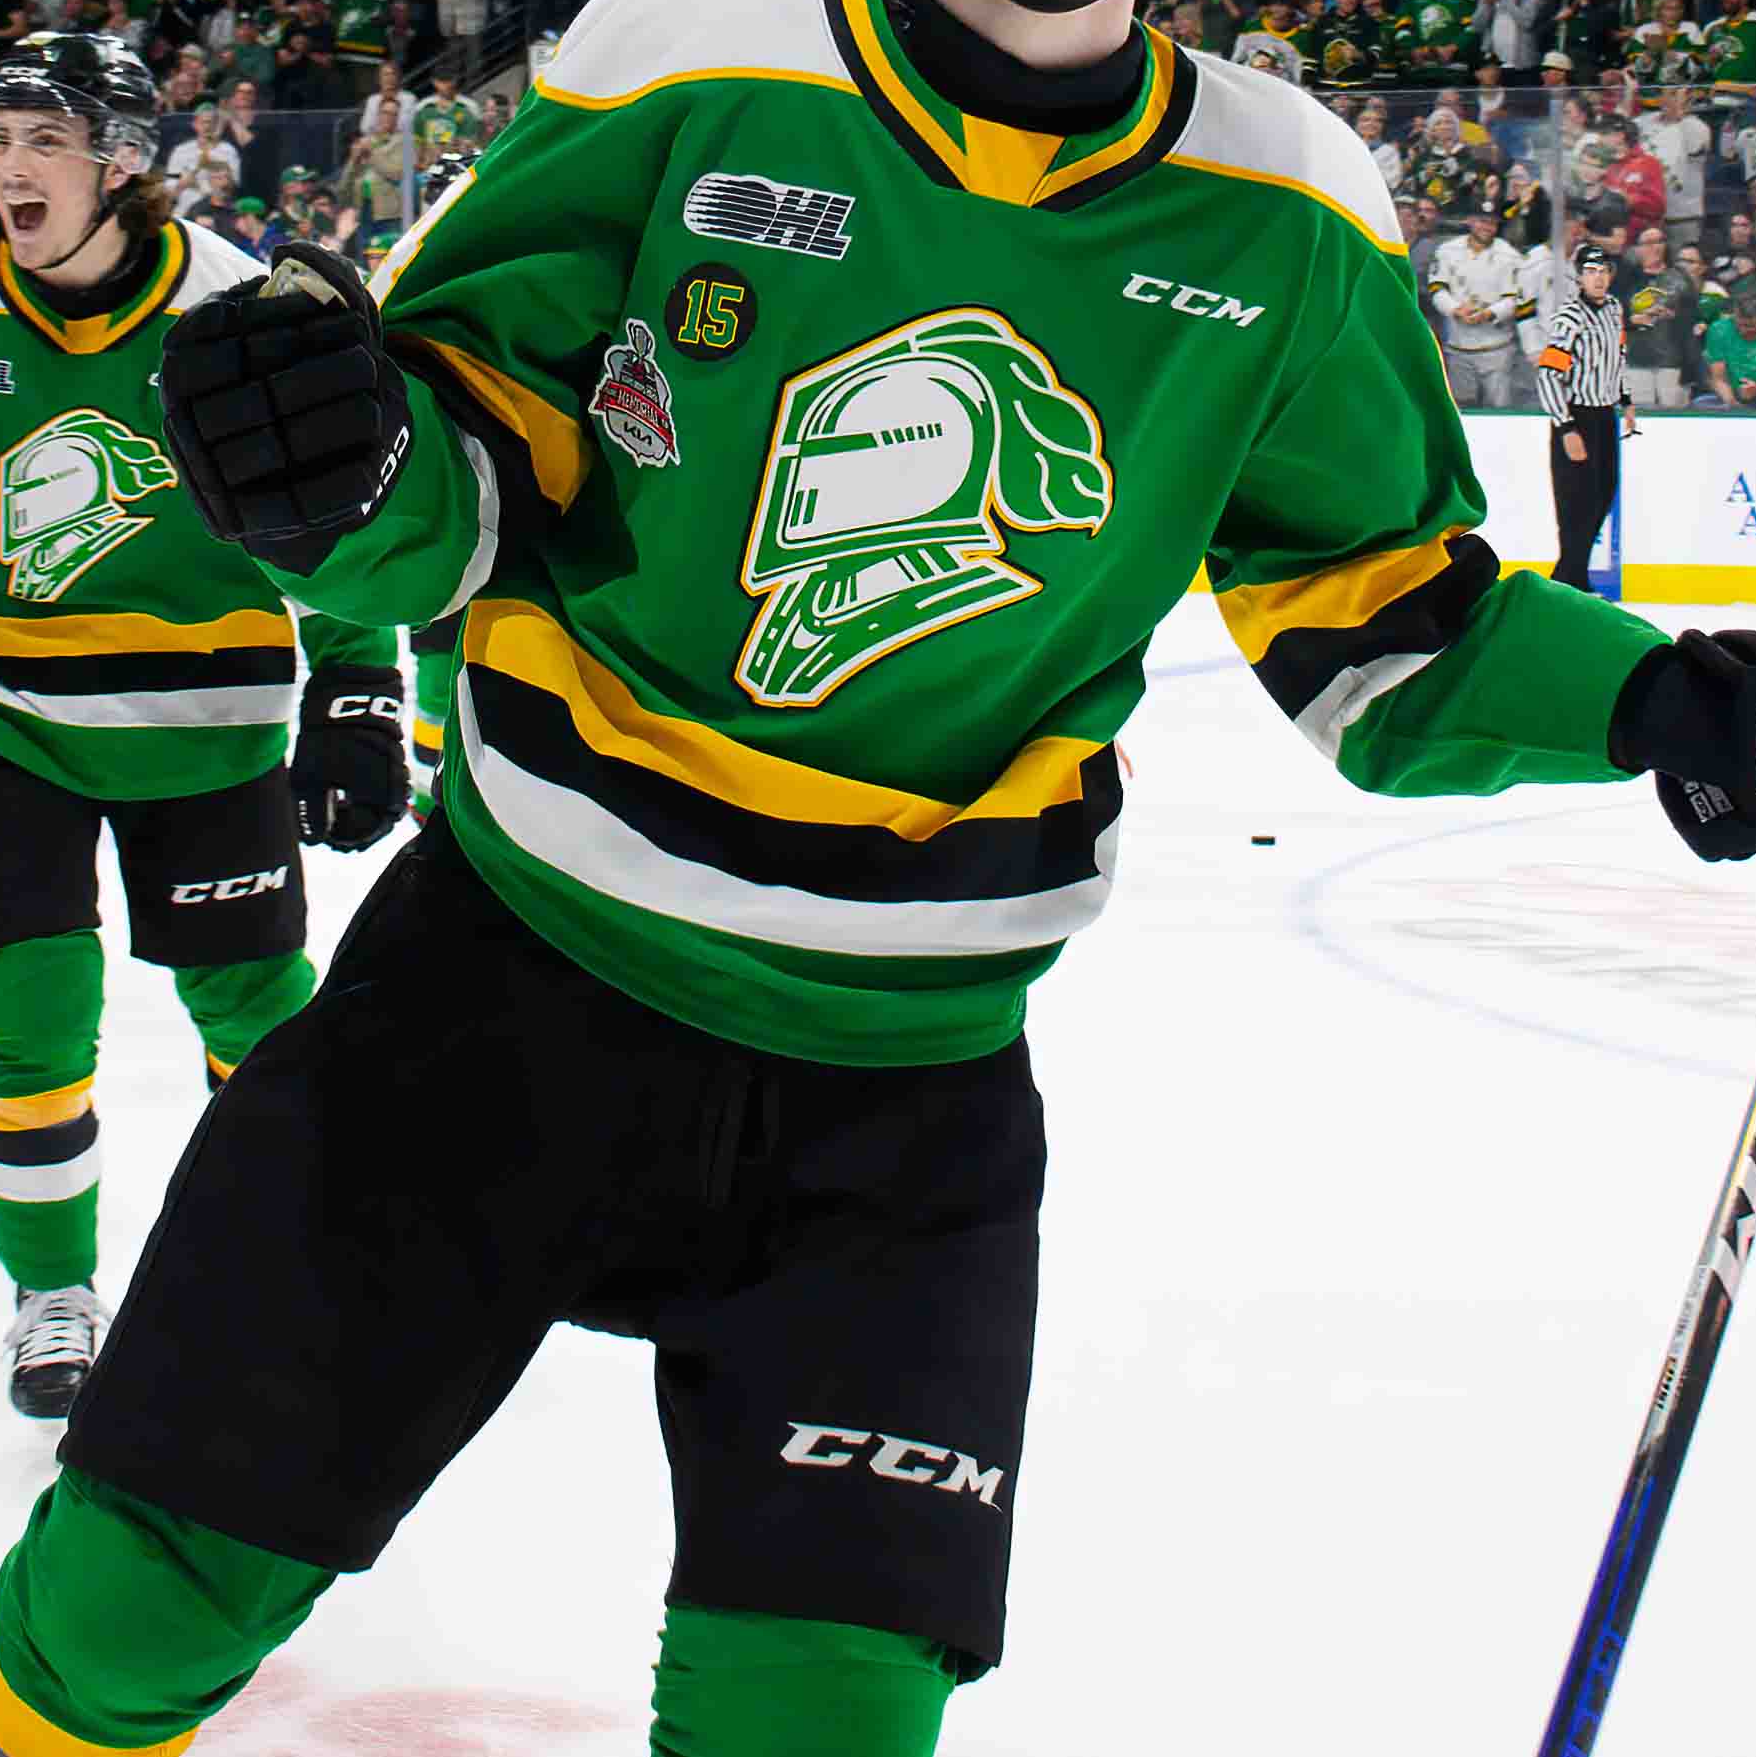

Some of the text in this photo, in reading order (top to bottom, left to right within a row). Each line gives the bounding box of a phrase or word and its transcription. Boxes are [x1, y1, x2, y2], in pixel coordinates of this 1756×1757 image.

[683, 172, 855, 259] OHL
[678, 279, 744, 347] 15
[1123, 273, 1266, 328] CCM
[170, 865, 289, 904] CCM
[780, 1421, 1003, 1512] CCM
